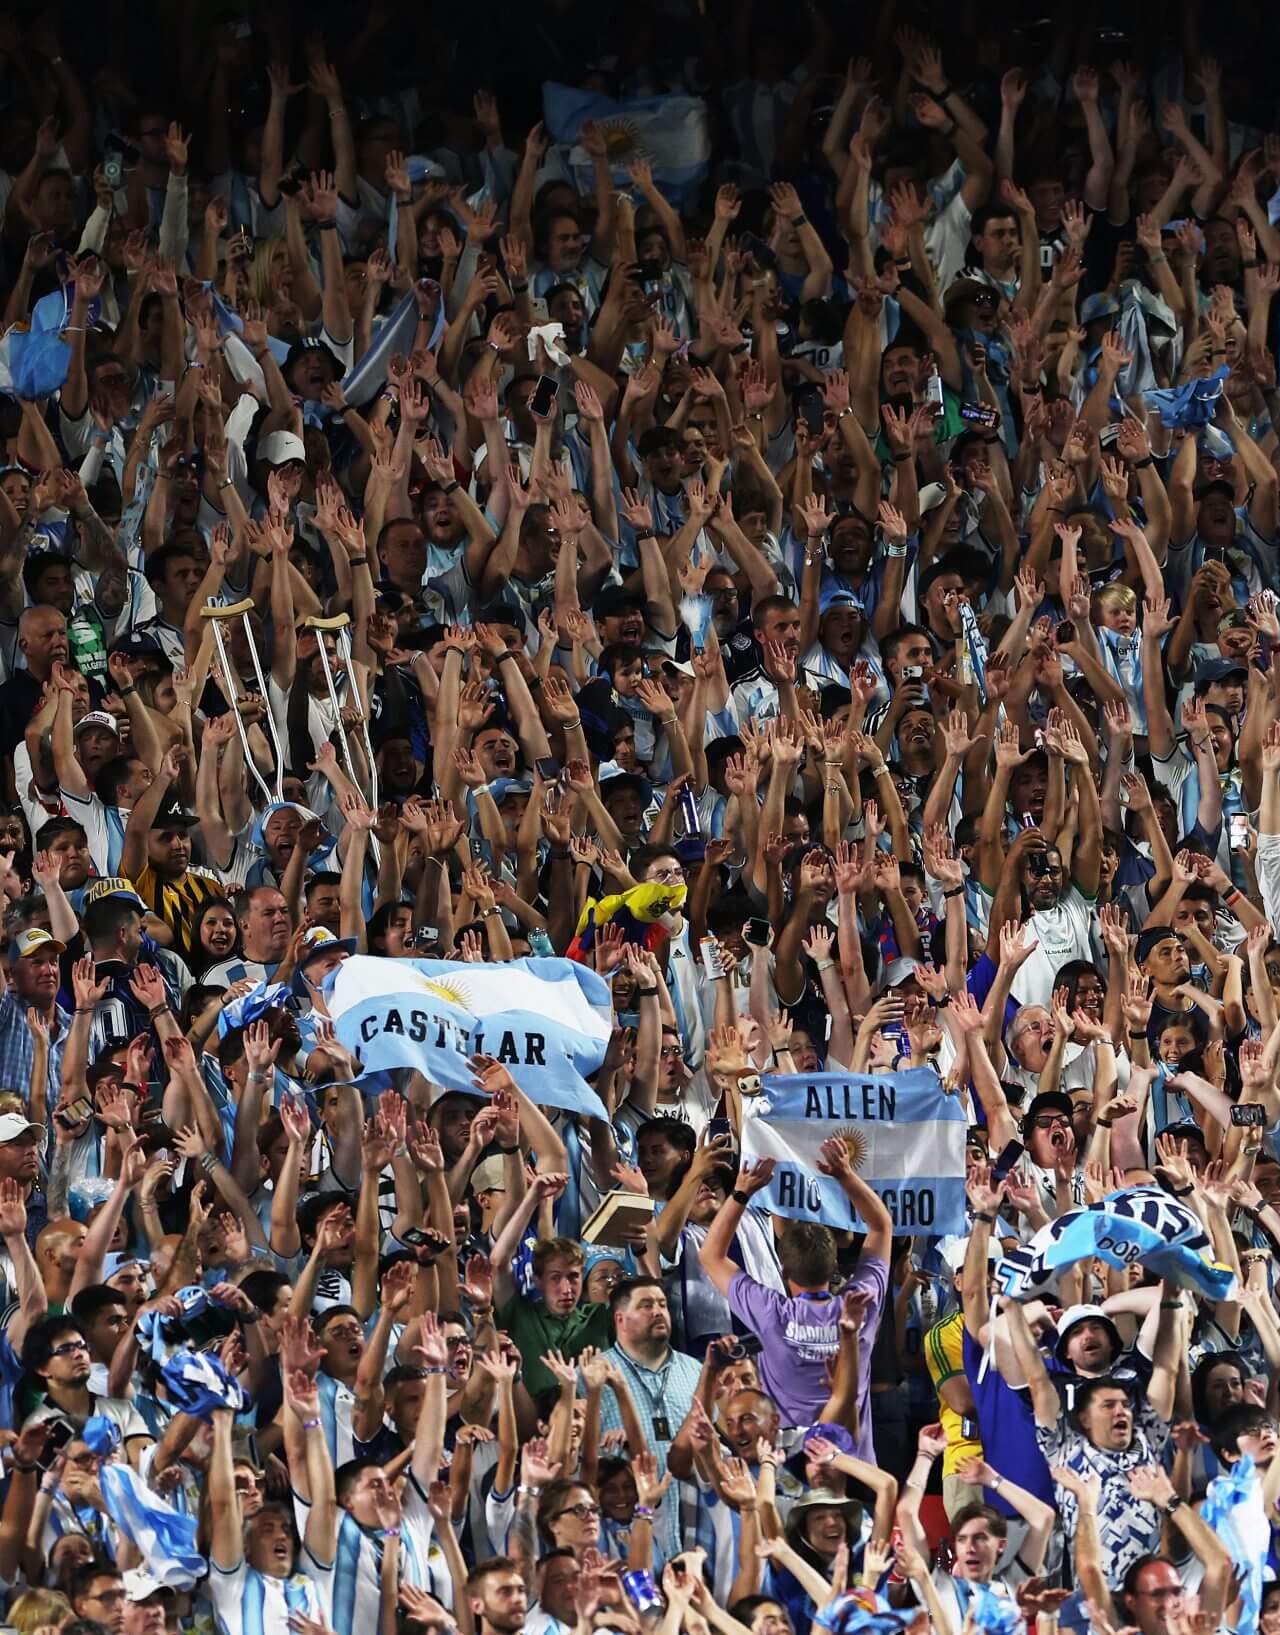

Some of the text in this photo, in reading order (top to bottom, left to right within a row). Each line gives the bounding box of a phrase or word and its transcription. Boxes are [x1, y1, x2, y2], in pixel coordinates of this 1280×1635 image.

[167, 801, 182, 815] A
[805, 1085, 896, 1121] ALLEN
[779, 1171, 935, 1228] RIO GRO
[784, 1321, 838, 1343] STADIUM
